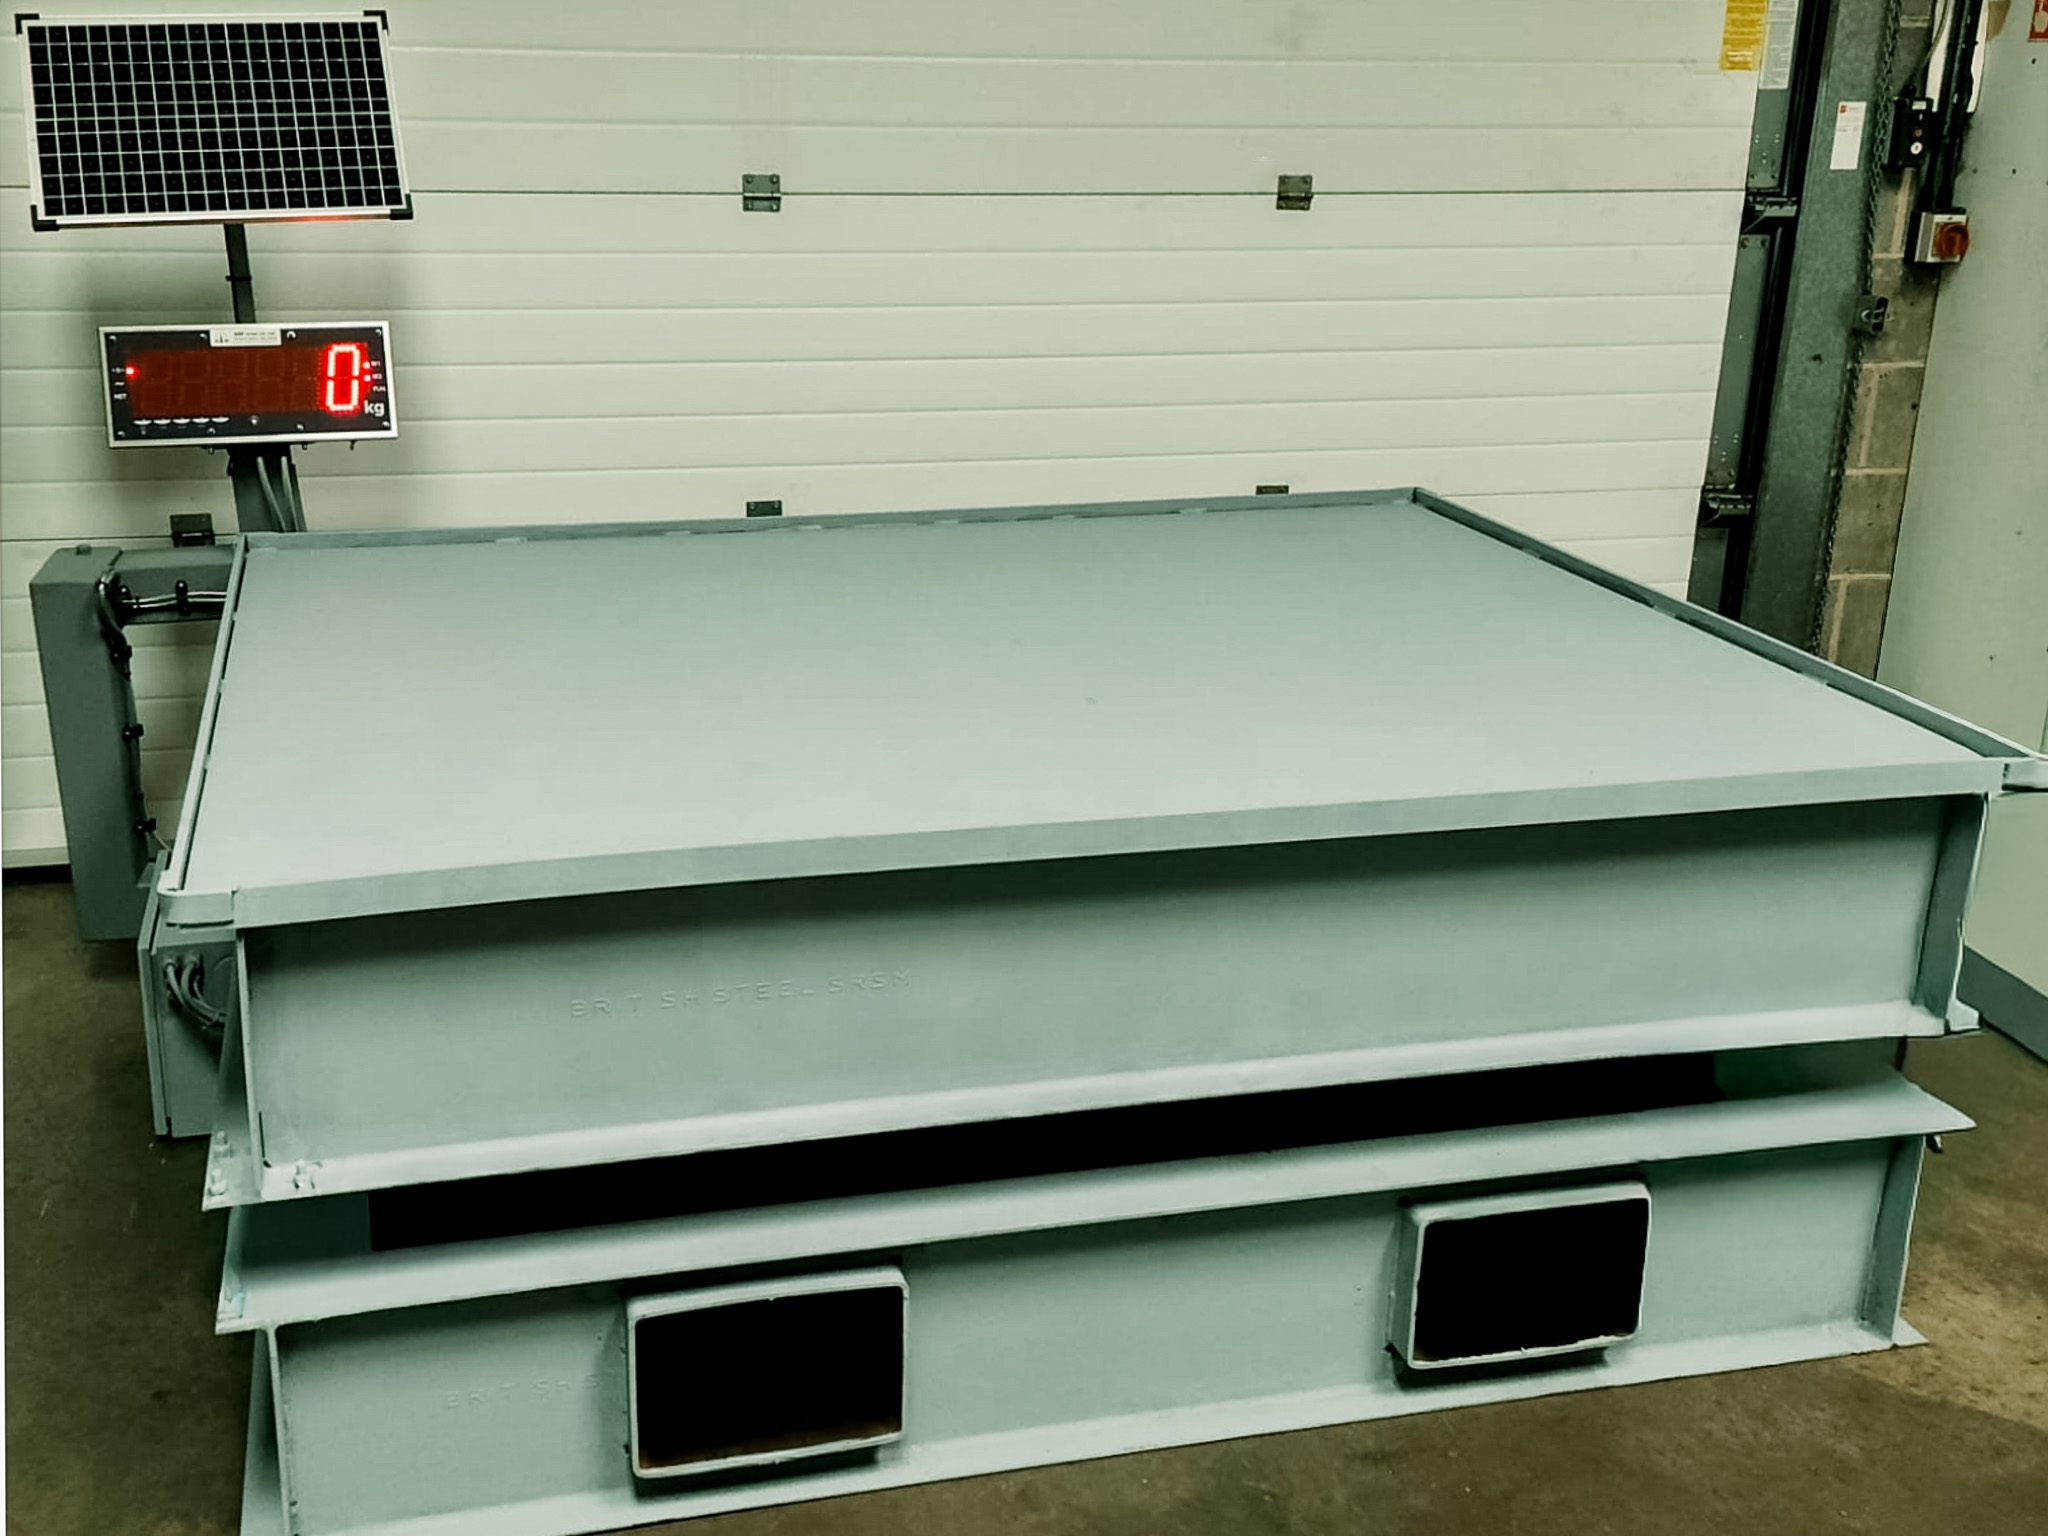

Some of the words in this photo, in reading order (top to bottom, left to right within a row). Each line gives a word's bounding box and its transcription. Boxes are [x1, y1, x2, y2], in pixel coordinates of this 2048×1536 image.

[325, 343, 361, 411] 0
[363, 400, 385, 417] kg
[570, 990, 702, 1019] BRTSH
[828, 969, 911, 994] SRSM
[446, 1377, 571, 1408] BRTSH
